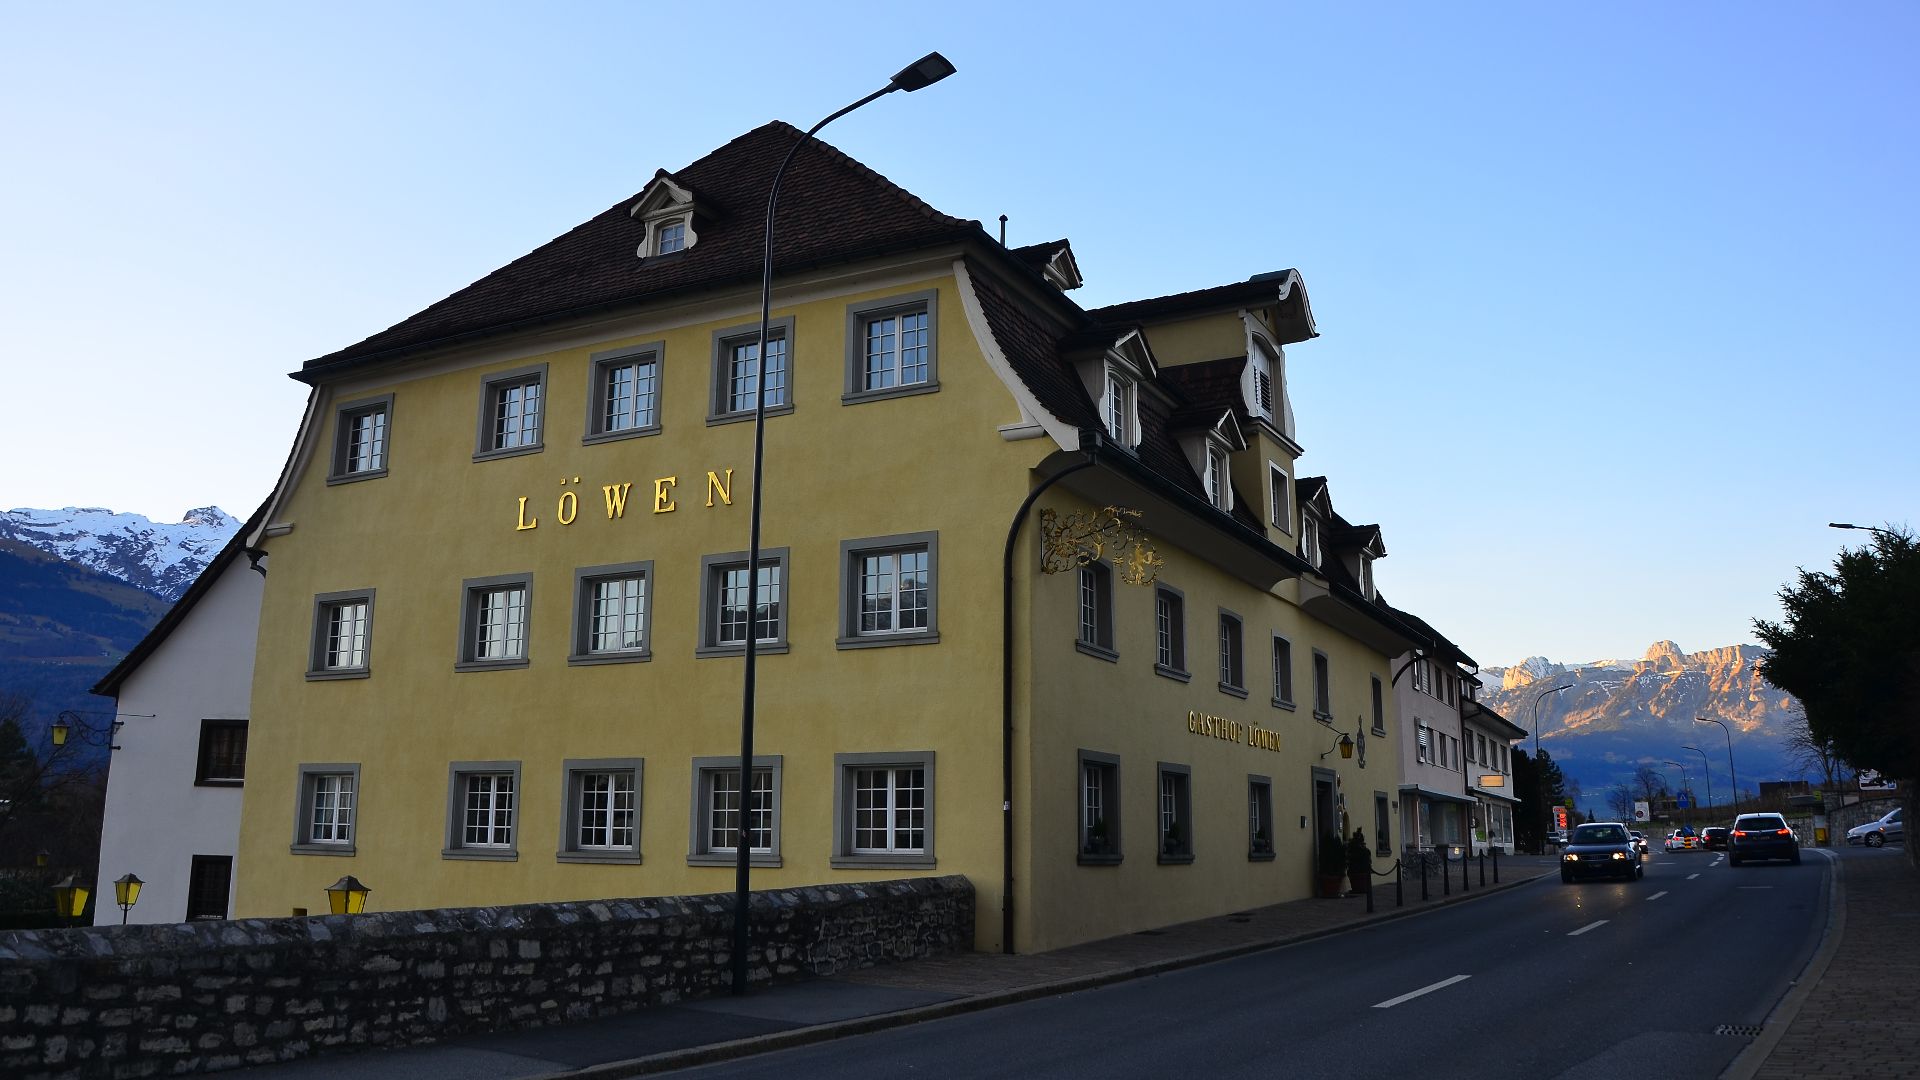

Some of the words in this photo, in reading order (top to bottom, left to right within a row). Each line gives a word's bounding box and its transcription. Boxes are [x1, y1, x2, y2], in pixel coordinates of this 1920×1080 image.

[515, 468, 734, 531] LÖWEN
[1188, 710, 1243, 743] GASTHOF
[1247, 720, 1281, 752] LÖWEN
